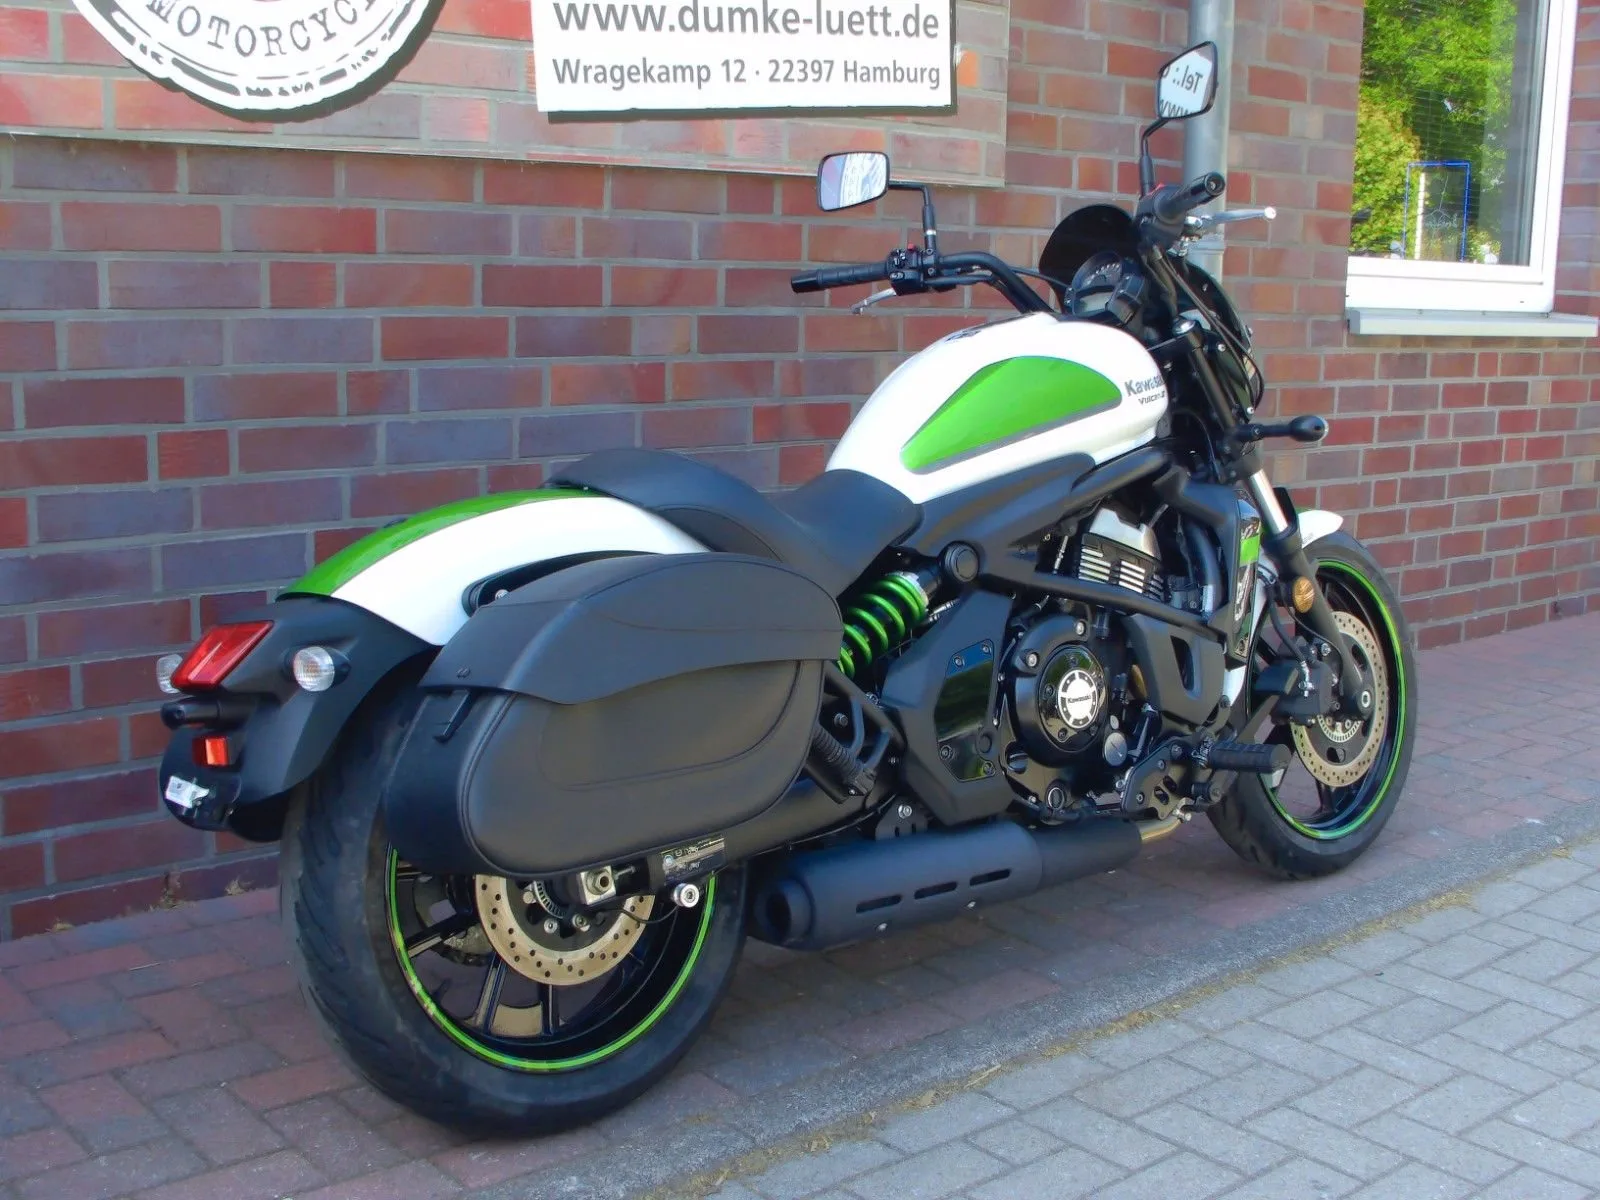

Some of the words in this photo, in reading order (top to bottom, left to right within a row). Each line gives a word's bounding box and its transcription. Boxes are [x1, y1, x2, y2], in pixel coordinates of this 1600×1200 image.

[145, 0, 376, 57] MOTORCYC
[553, 0, 939, 39] www.dumke-luett.de
[552, 57, 711, 91] Wragekamp
[721, 59, 747, 83] 12
[768, 59, 835, 83] 22397
[844, 60, 940, 91] Hamburg
